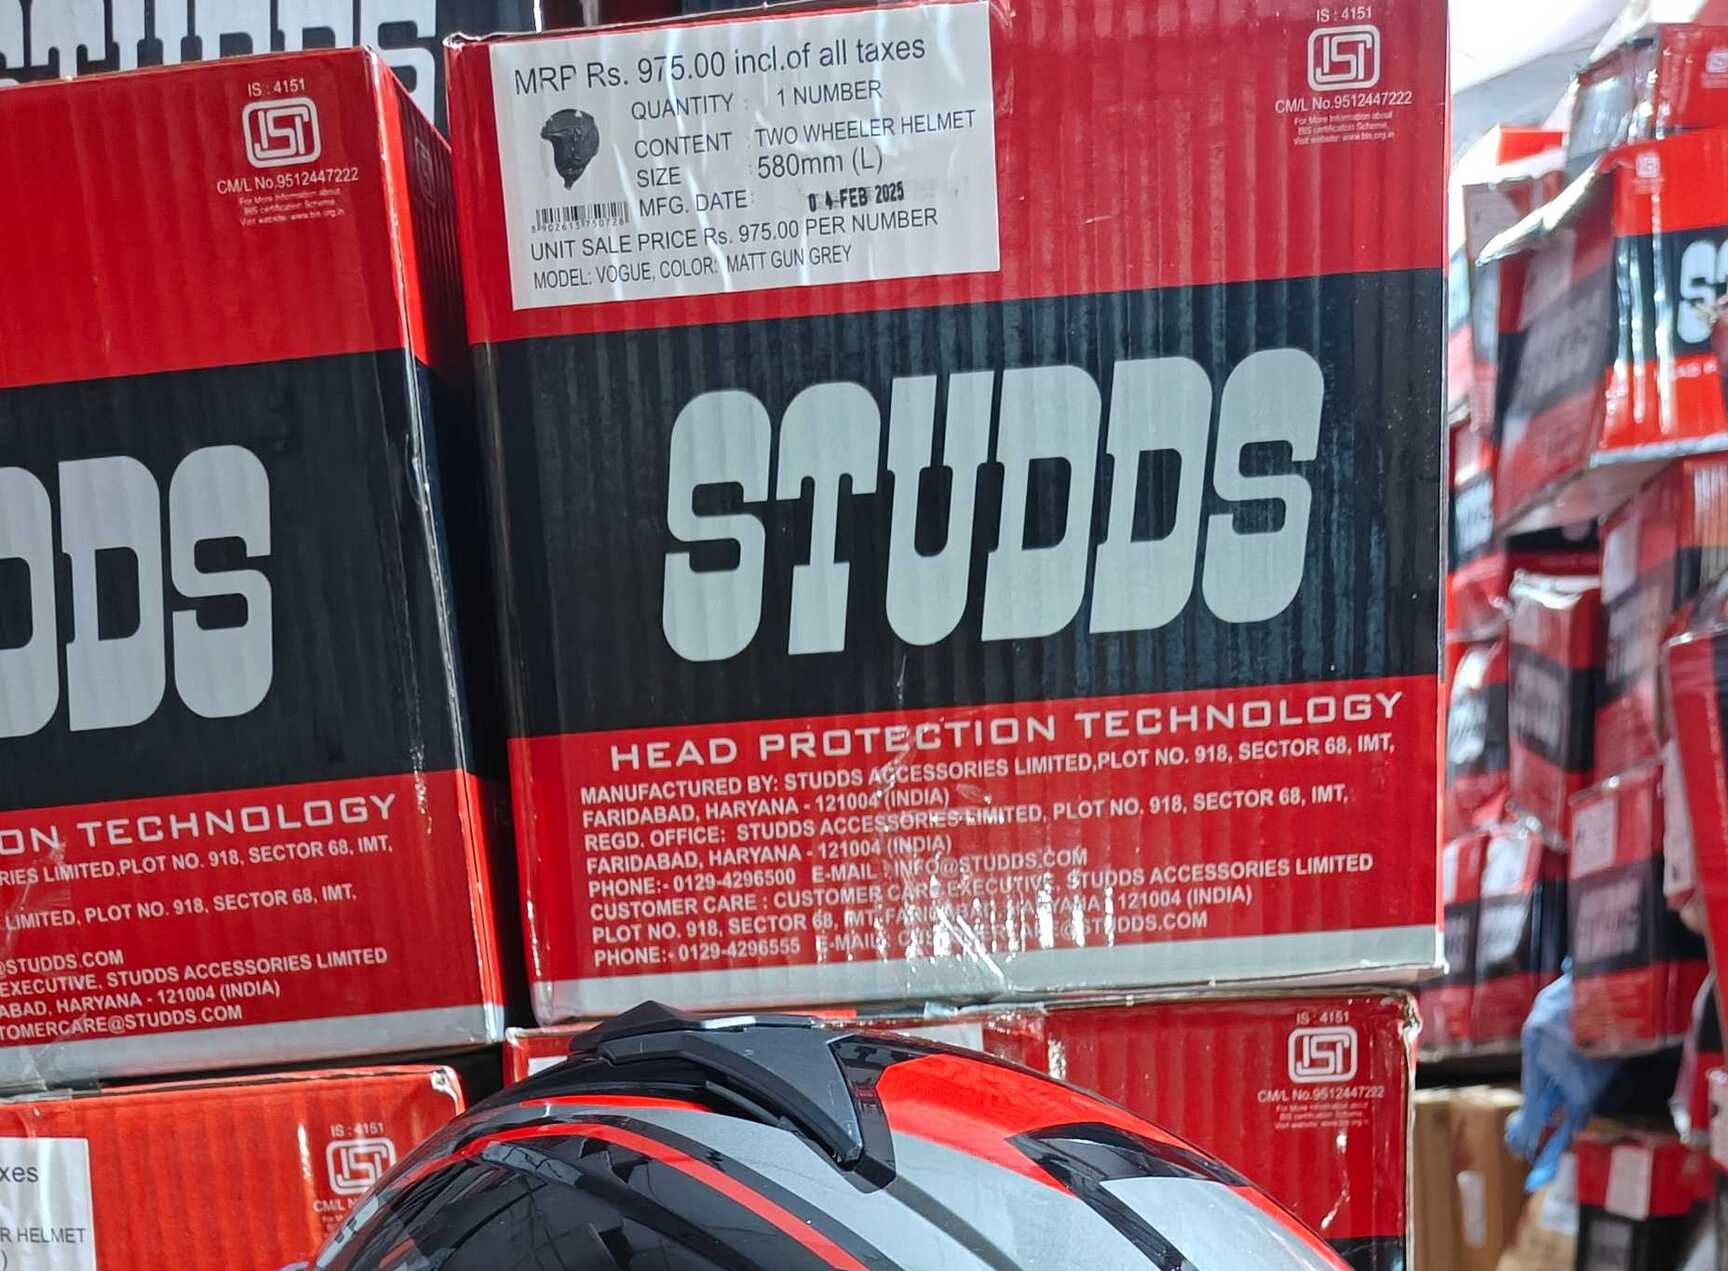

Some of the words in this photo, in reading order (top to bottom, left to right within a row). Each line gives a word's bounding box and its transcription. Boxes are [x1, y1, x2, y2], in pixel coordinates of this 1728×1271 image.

[1316, 7, 1330, 23] IS
[1341, 5, 1372, 20] 4151
[247, 81, 265, 97] IS
[273, 77, 305, 93] 4151
[514, 64, 577, 95] MRP
[586, 61, 629, 88] Rs.
[637, 51, 725, 83] 975.00
[734, 42, 811, 74] incl.of
[819, 38, 847, 67] all
[855, 39, 925, 63] taxes
[631, 93, 734, 120] QUANTITY
[777, 88, 785, 107] 1
[793, 79, 883, 105] NUMBER
[634, 131, 733, 159] CONTENT
[754, 125, 798, 147] TWO
[802, 117, 896, 142] WHEELER
[900, 109, 976, 134] HELMET
[637, 166, 682, 188] SIZE
[758, 153, 843, 179] 580mm
[852, 145, 883, 176] (L)
[639, 195, 690, 217] MFG.
[840, 185, 868, 208] FEB
[874, 180, 904, 204] 2025
[530, 239, 576, 261] UNIT
[582, 234, 633, 257] SALE
[637, 228, 699, 251] PRICE
[704, 227, 733, 246] Rs.
[738, 220, 799, 243] 975.00
[805, 215, 846, 236] PER
[852, 207, 938, 232] NUMBER
[533, 268, 592, 289] MODEL:
[595, 262, 656, 284] VOGUE,
[659, 256, 718, 279] COLOR:
[726, 251, 767, 273] MATT
[770, 248, 804, 269] GUN
[809, 244, 852, 265] GREY
[663, 348, 1326, 663] STUDDS
[610, 738, 738, 771] HEAD
[759, 717, 1055, 759] PROTECTION
[1074, 692, 1403, 737] TECHNOLOGY
[76, 795, 396, 845] TECHNOLOGY
[17, 1228, 86, 1243] HELMET
